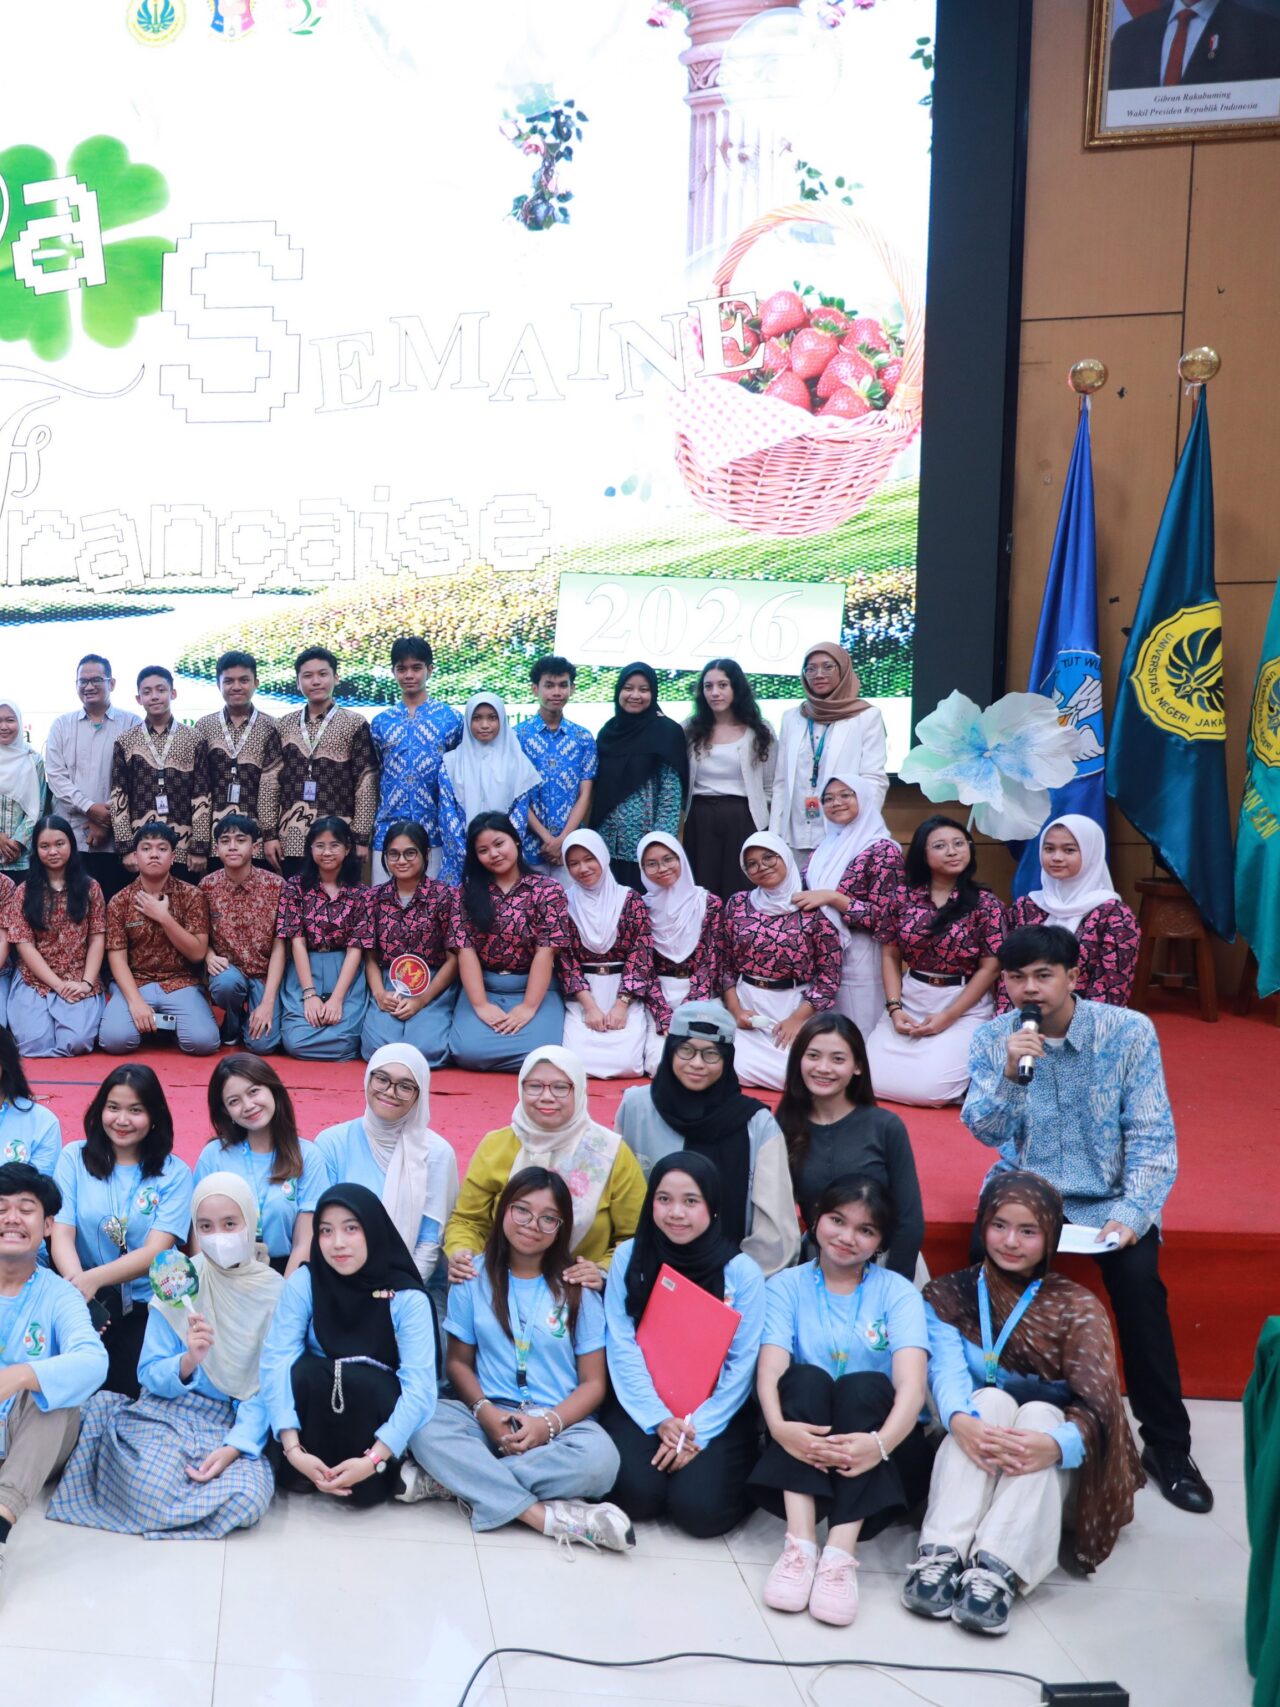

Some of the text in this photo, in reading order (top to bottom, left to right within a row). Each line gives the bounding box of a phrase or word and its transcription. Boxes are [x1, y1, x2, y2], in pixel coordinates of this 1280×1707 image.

[1153, 90, 1232, 104] Gibran Rakabuming
[1126, 102, 1259, 118] Wakil Presiden Republik Indonesia
[579, 582, 804, 662] 2026
[1061, 656, 1082, 669] TUT
[1148, 632, 1174, 695] UNIVERSITAS
[1156, 696, 1191, 724] NEGERI
